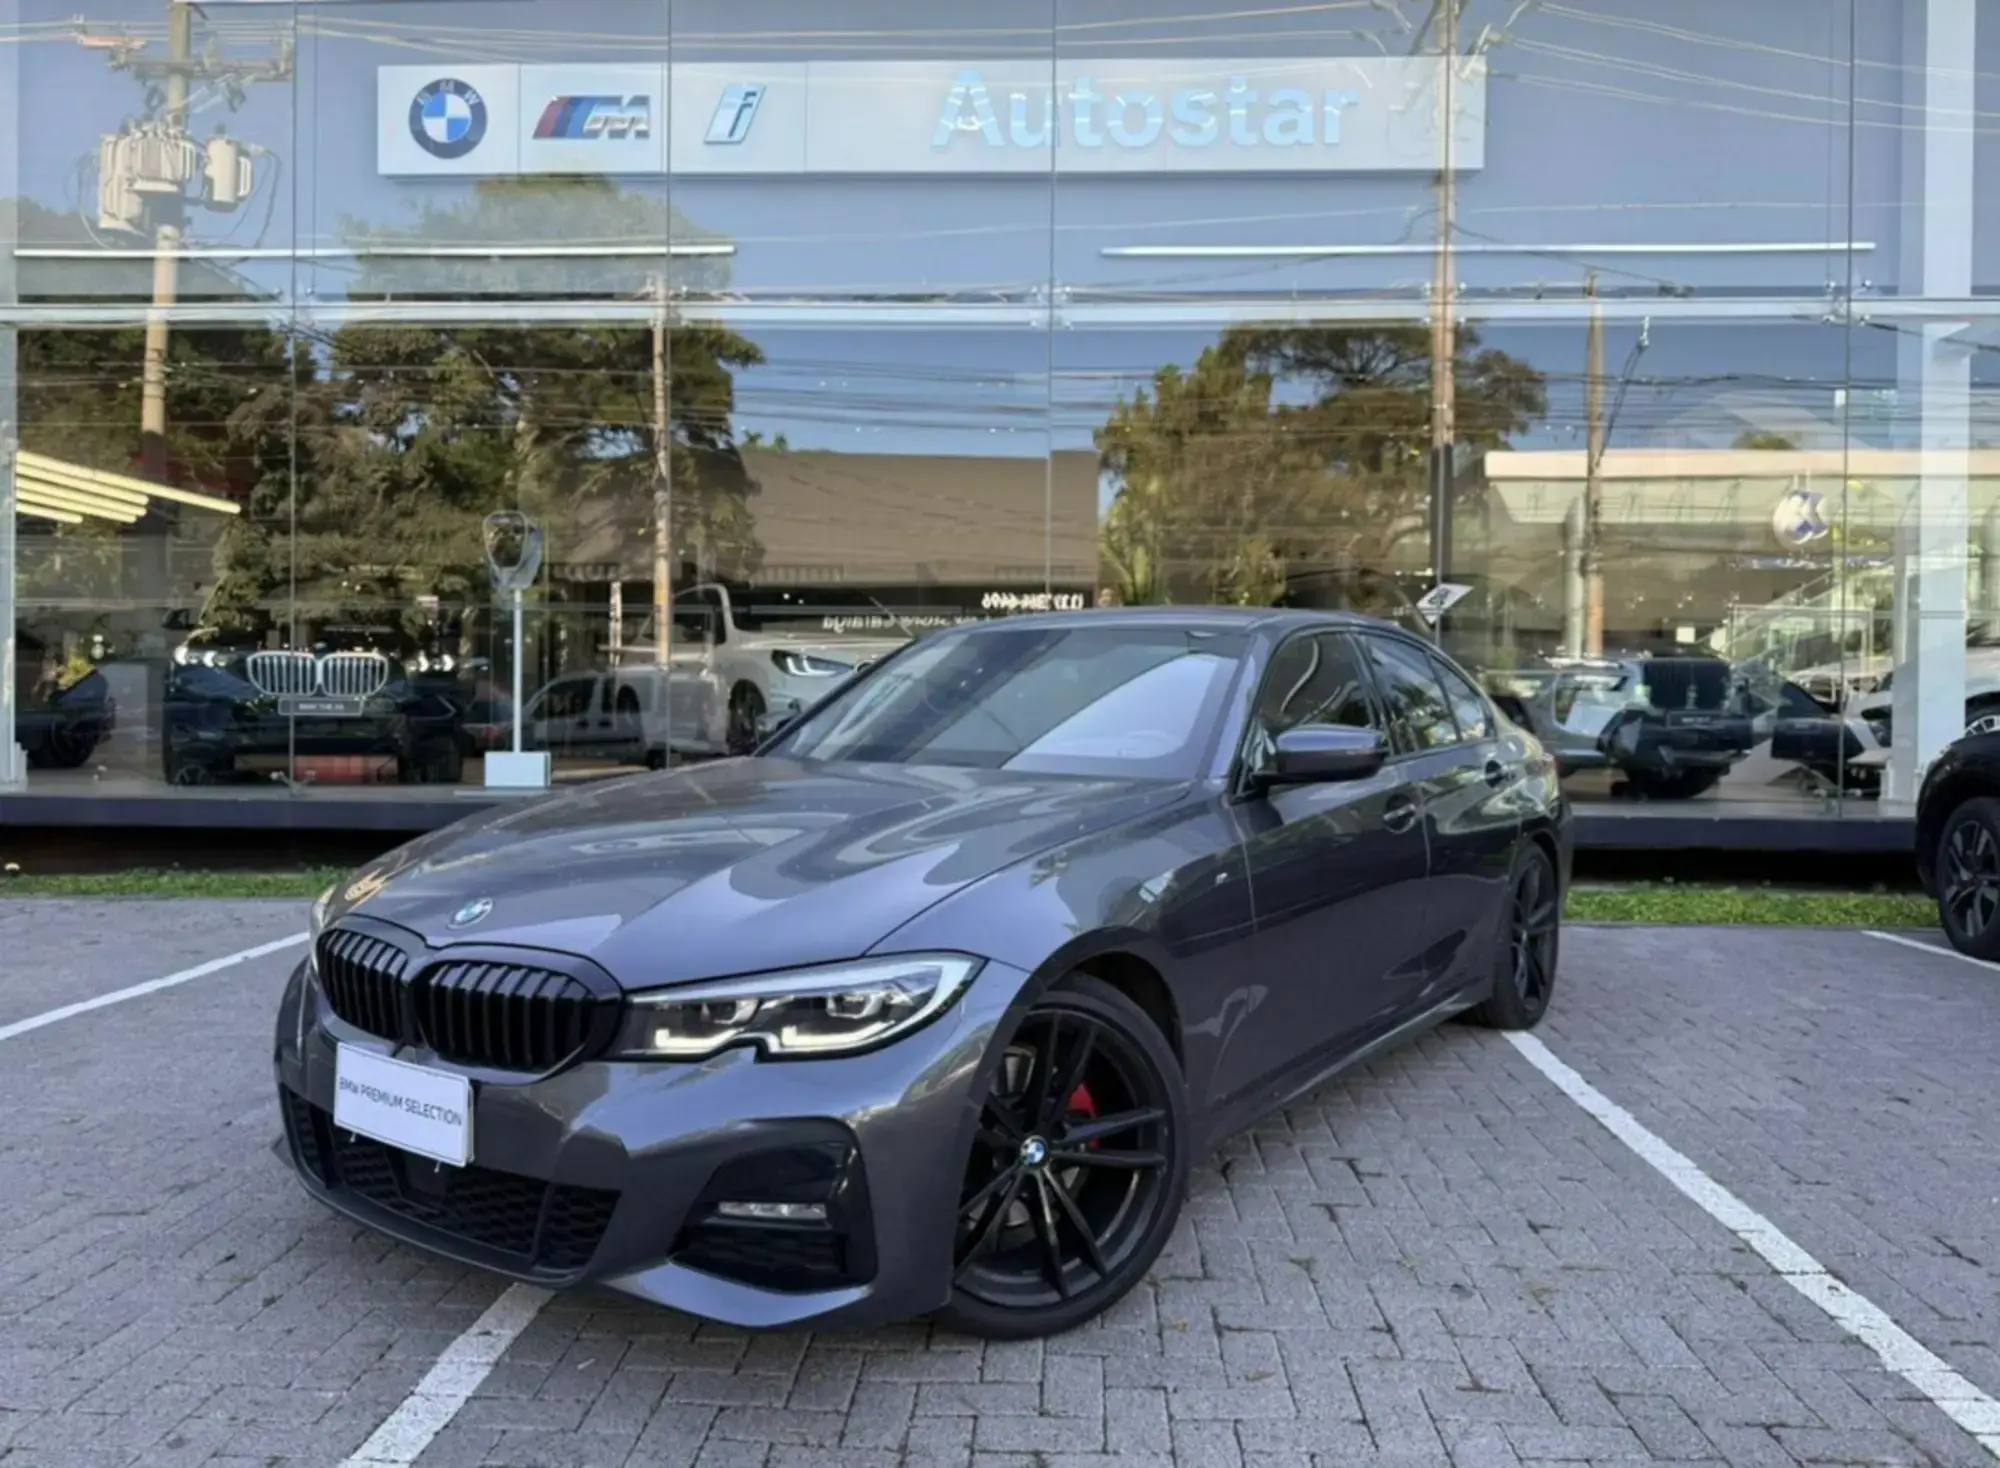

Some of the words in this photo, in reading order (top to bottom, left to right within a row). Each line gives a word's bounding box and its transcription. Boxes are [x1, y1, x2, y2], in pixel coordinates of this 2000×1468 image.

[930, 68, 1361, 147] Autostar
[360, 1083, 403, 1109] PREMIUM
[404, 1098, 462, 1126] SELECTION
